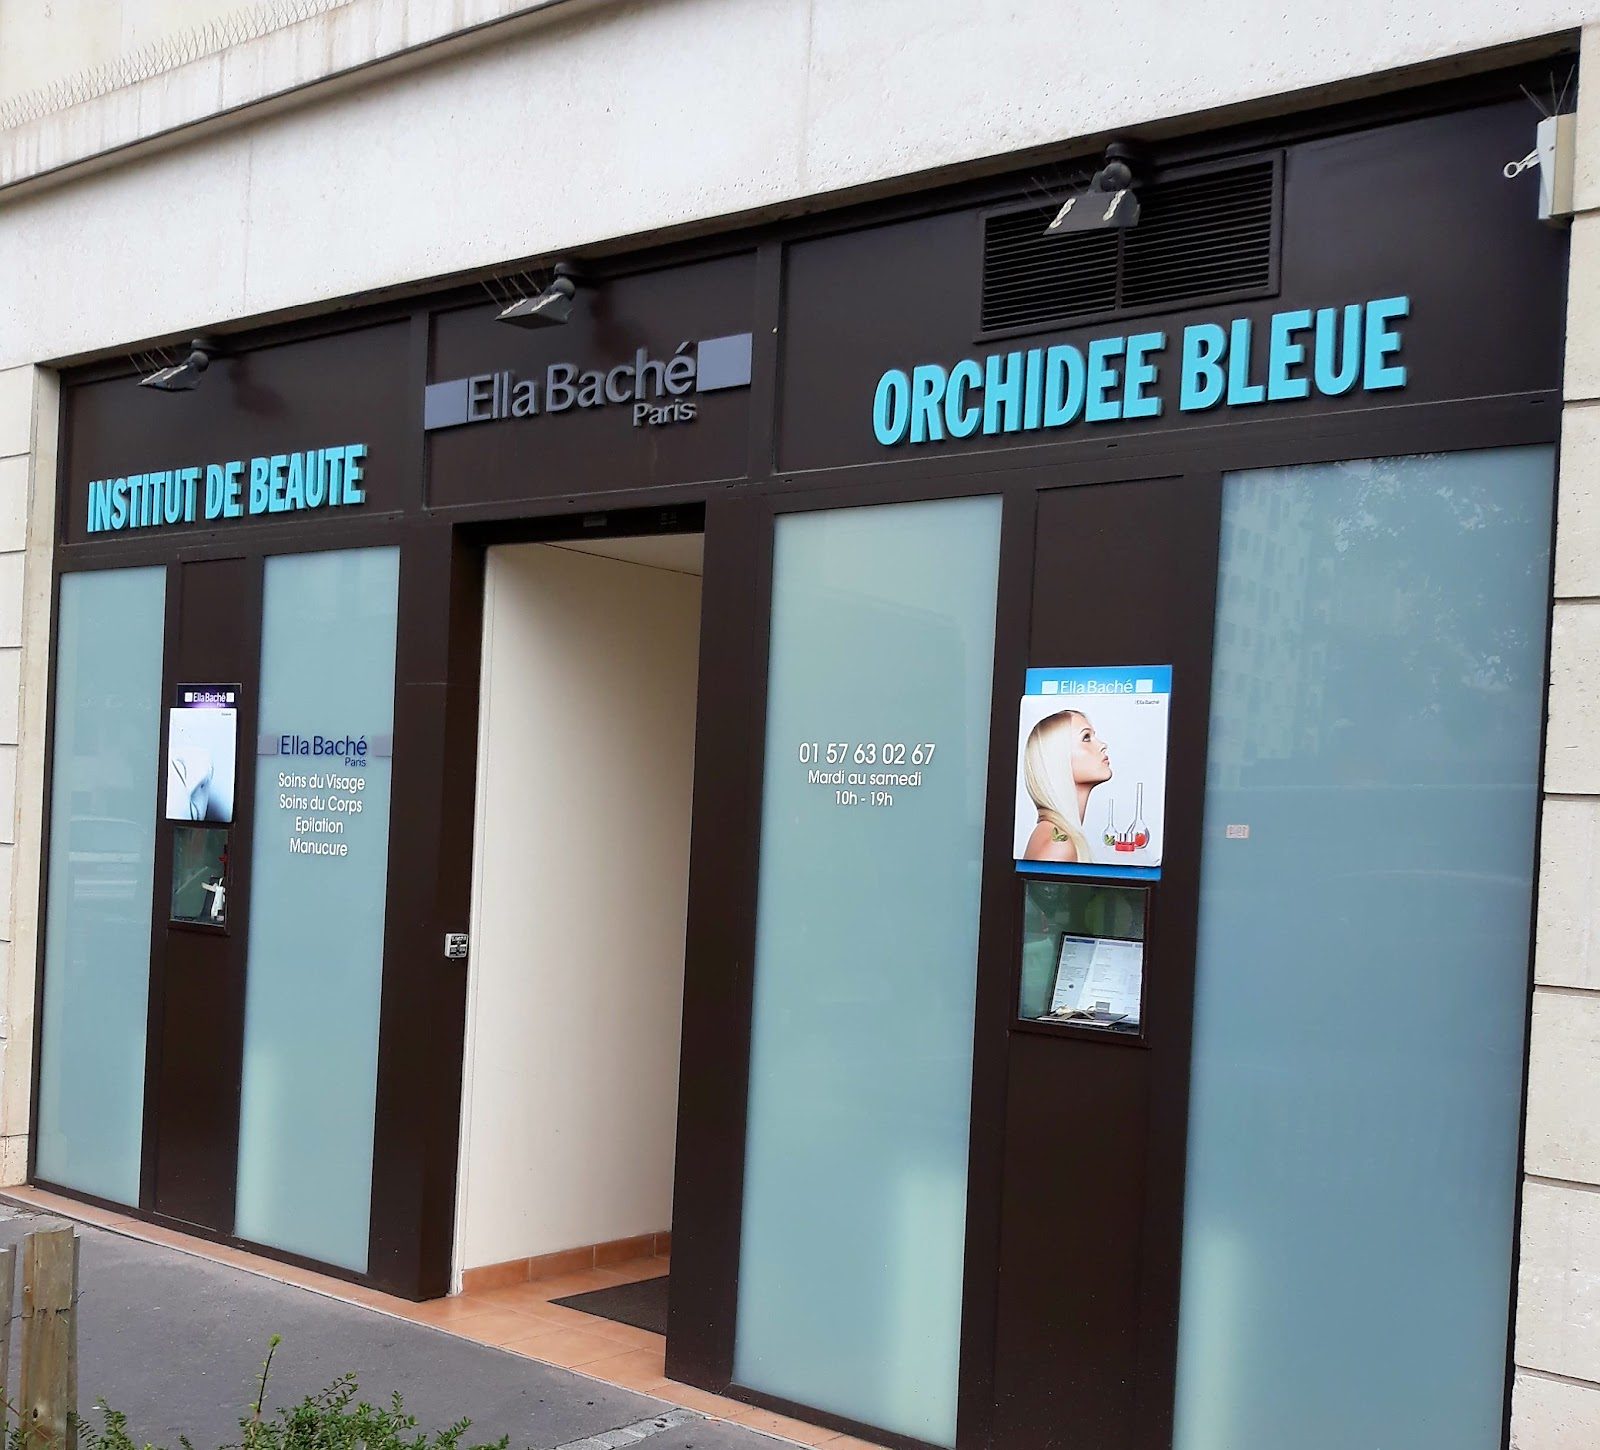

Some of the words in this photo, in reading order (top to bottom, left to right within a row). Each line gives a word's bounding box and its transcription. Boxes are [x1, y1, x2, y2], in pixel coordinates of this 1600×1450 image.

[468, 371, 539, 422] Ella
[546, 341, 698, 413] Baché
[873, 332, 1165, 446] ORCHIDEE
[1179, 296, 1409, 412] BLEUE
[633, 399, 697, 427] Paris
[87, 467, 201, 532] INSTITUT
[205, 461, 245, 520] DE
[249, 444, 367, 515] BEAUTE
[193, 692, 205, 702] Ella
[1060, 680, 1085, 694] Ella
[1087, 679, 1134, 694] Baché
[280, 735, 309, 755] Ella
[313, 735, 367, 756] Baché
[799, 743, 818, 763] 01
[826, 743, 849, 764] 57
[853, 743, 877, 764] 63
[882, 744, 906, 765] 02
[911, 744, 936, 765] 67
[344, 757, 367, 767] Paris
[278, 772, 307, 788] Soins
[309, 774, 324, 789] du
[326, 774, 366, 793] Visage
[808, 770, 845, 785] Mardi
[848, 773, 866, 785] au
[869, 771, 922, 786] samedi
[279, 793, 308, 809] Soins
[310, 795, 325, 811] du
[328, 796, 363, 815] Corps
[835, 790, 858, 805] 10h
[870, 791, 893, 806] 19h
[295, 816, 344, 834] Epilation
[289, 838, 348, 857] Manucure
